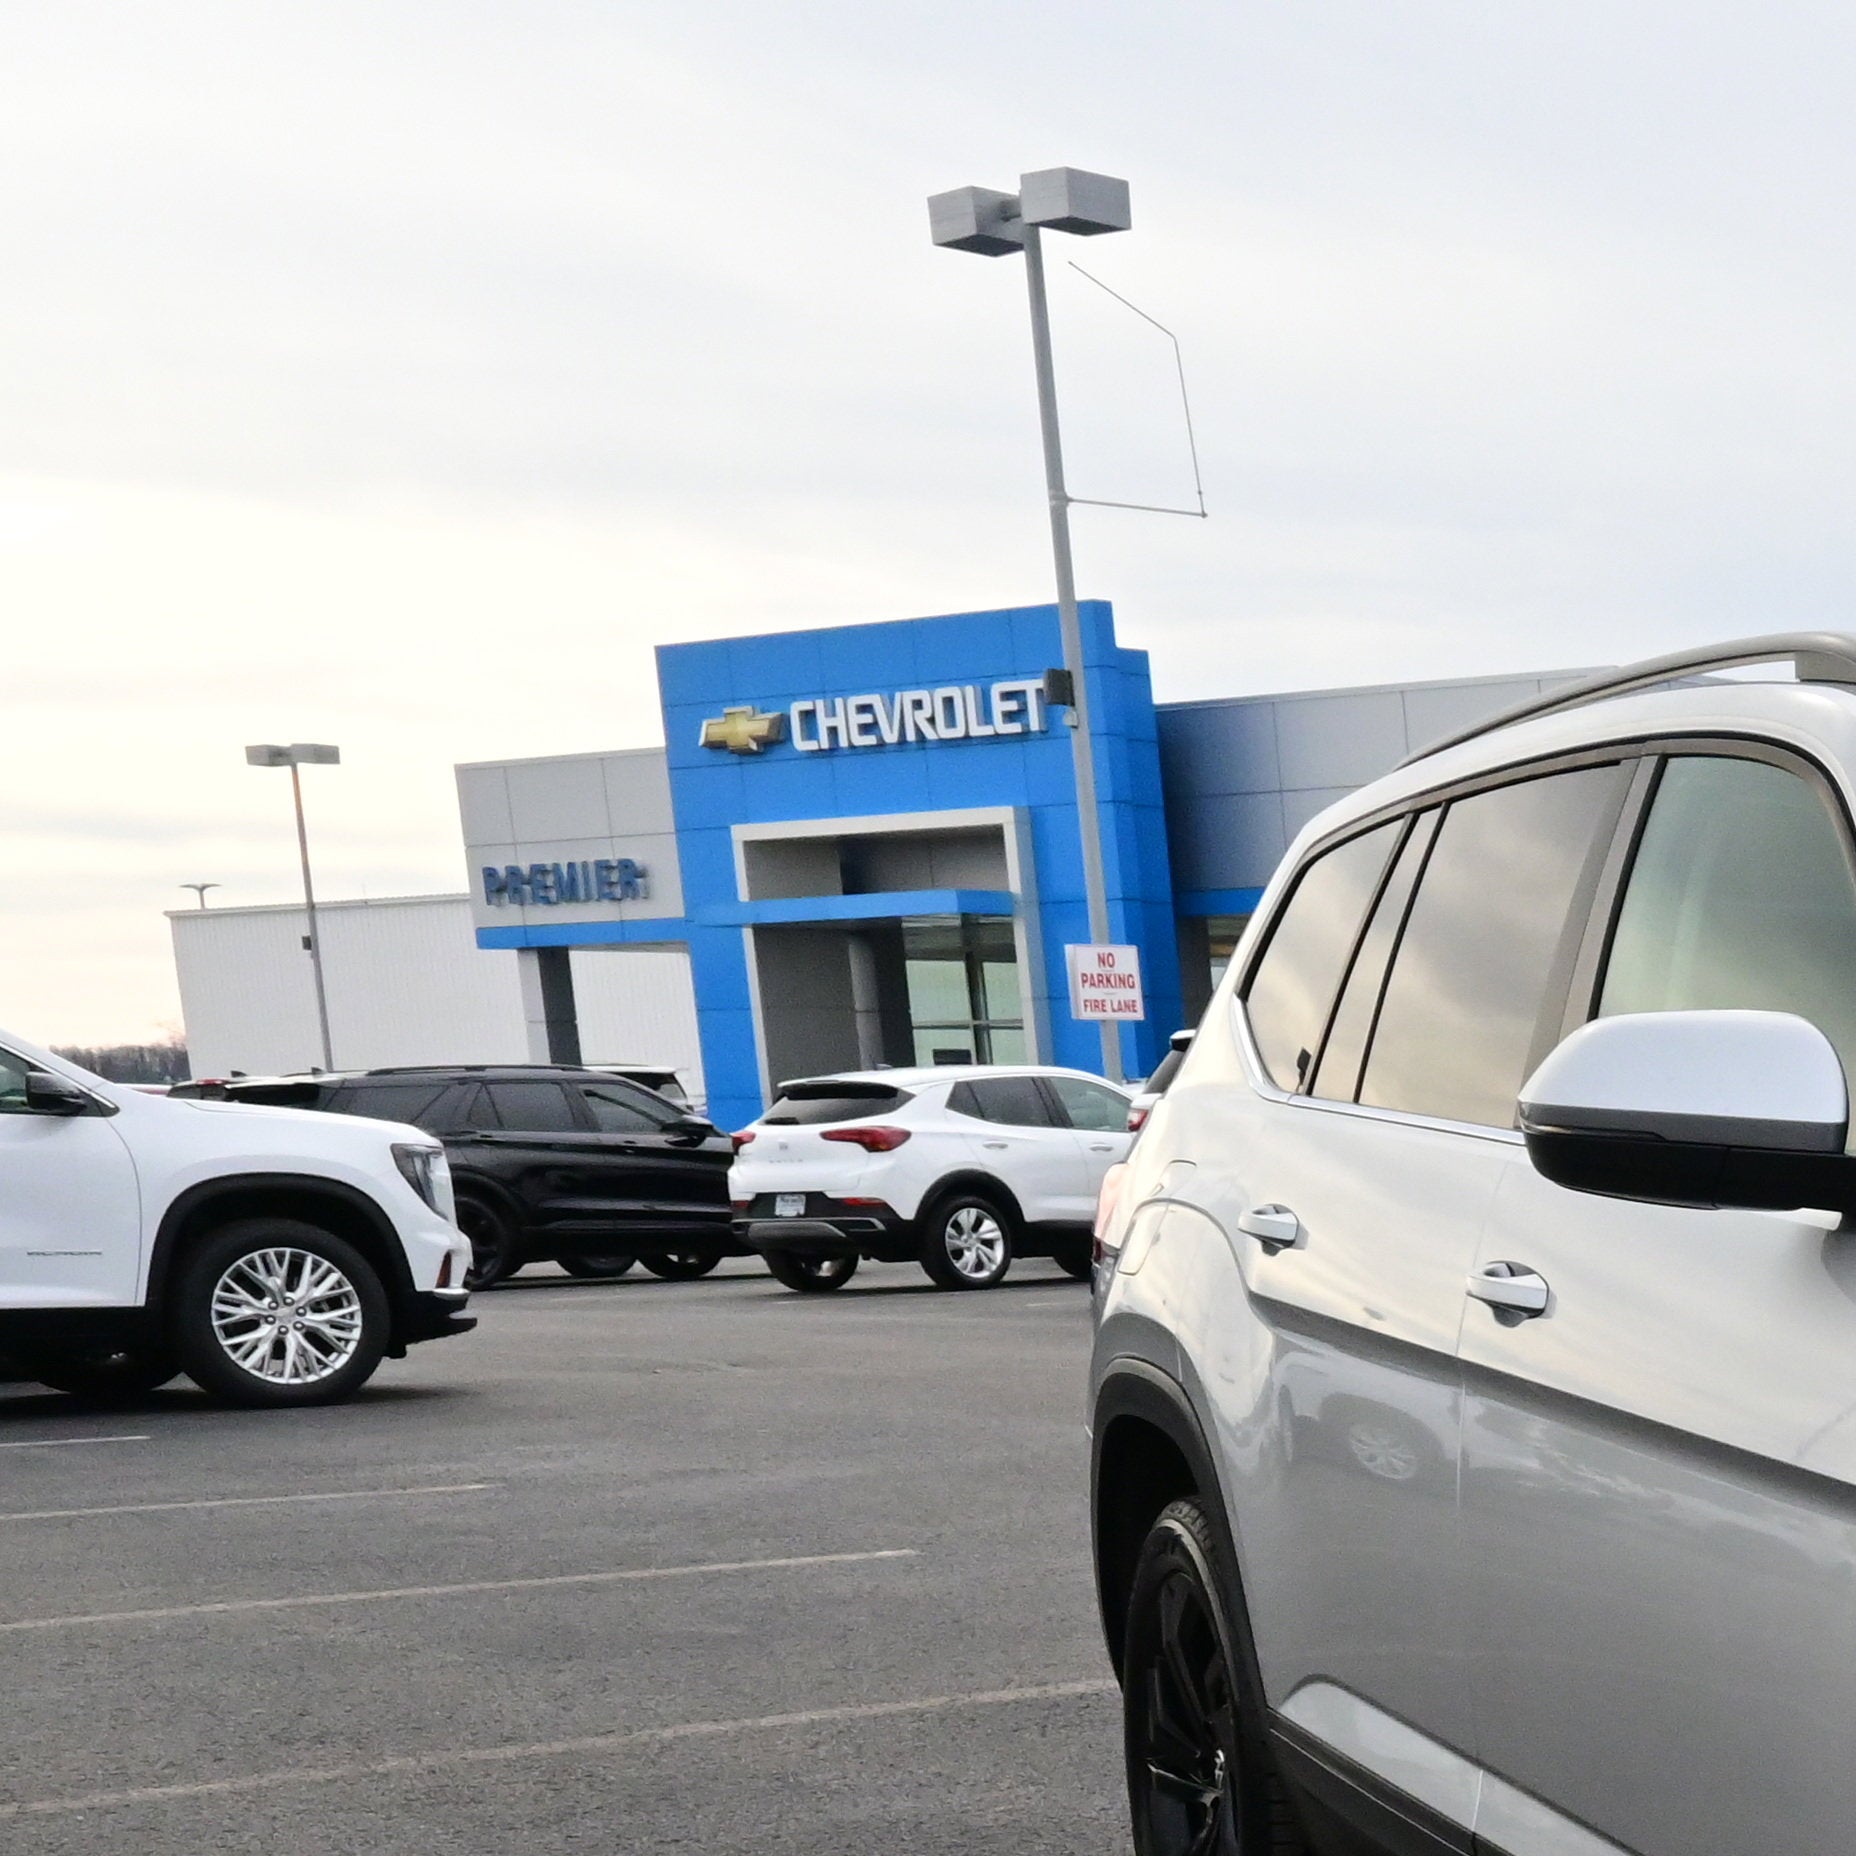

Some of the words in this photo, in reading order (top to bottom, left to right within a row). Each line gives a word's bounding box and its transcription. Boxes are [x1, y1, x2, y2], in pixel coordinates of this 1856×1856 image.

[790, 678, 1047, 752] CHEVROLET
[482, 858, 648, 906] PREMIER
[1097, 952, 1116, 968] NO
[1081, 973, 1136, 989] PARKING
[1083, 999, 1107, 1013] FIRE
[1110, 999, 1138, 1013] LANE
